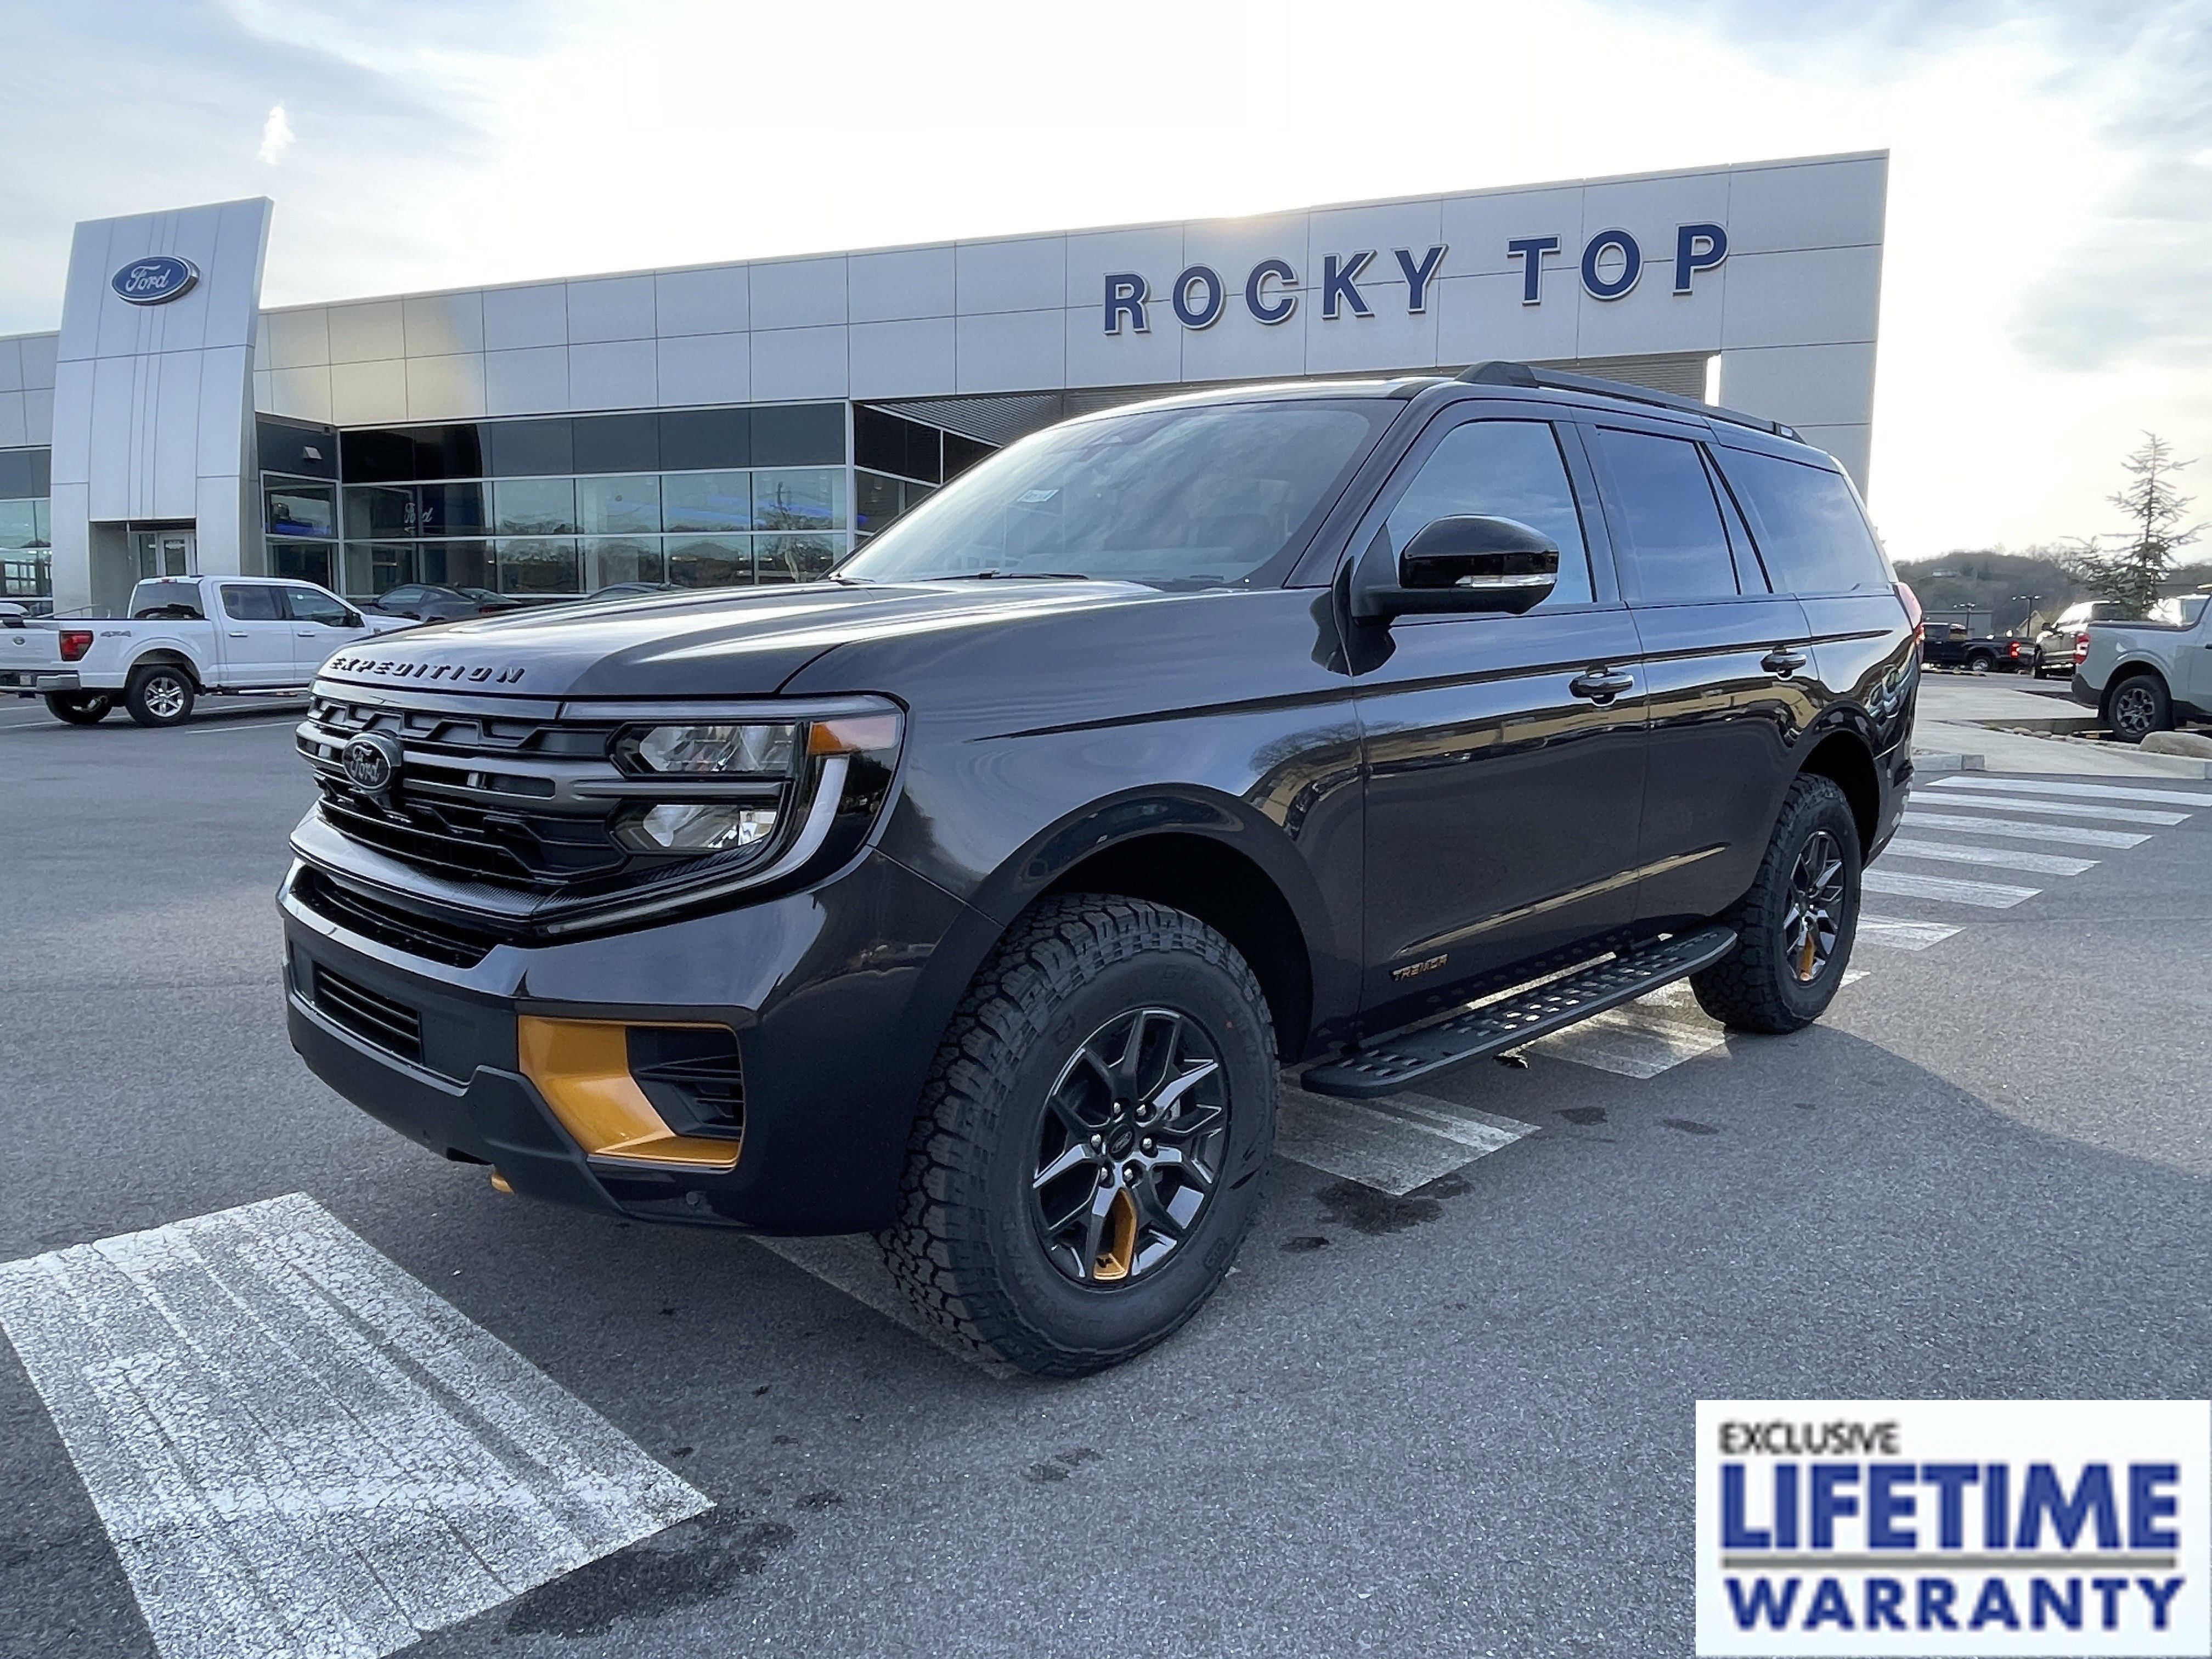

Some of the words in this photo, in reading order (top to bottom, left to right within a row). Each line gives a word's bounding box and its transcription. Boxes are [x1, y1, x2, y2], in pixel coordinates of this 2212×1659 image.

[125, 264, 171, 292] Ford
[1103, 244, 1449, 335] ROCKY
[1507, 221, 1729, 306] TOP
[329, 657, 525, 684] EXPEDITION
[350, 745, 380, 783] Ford
